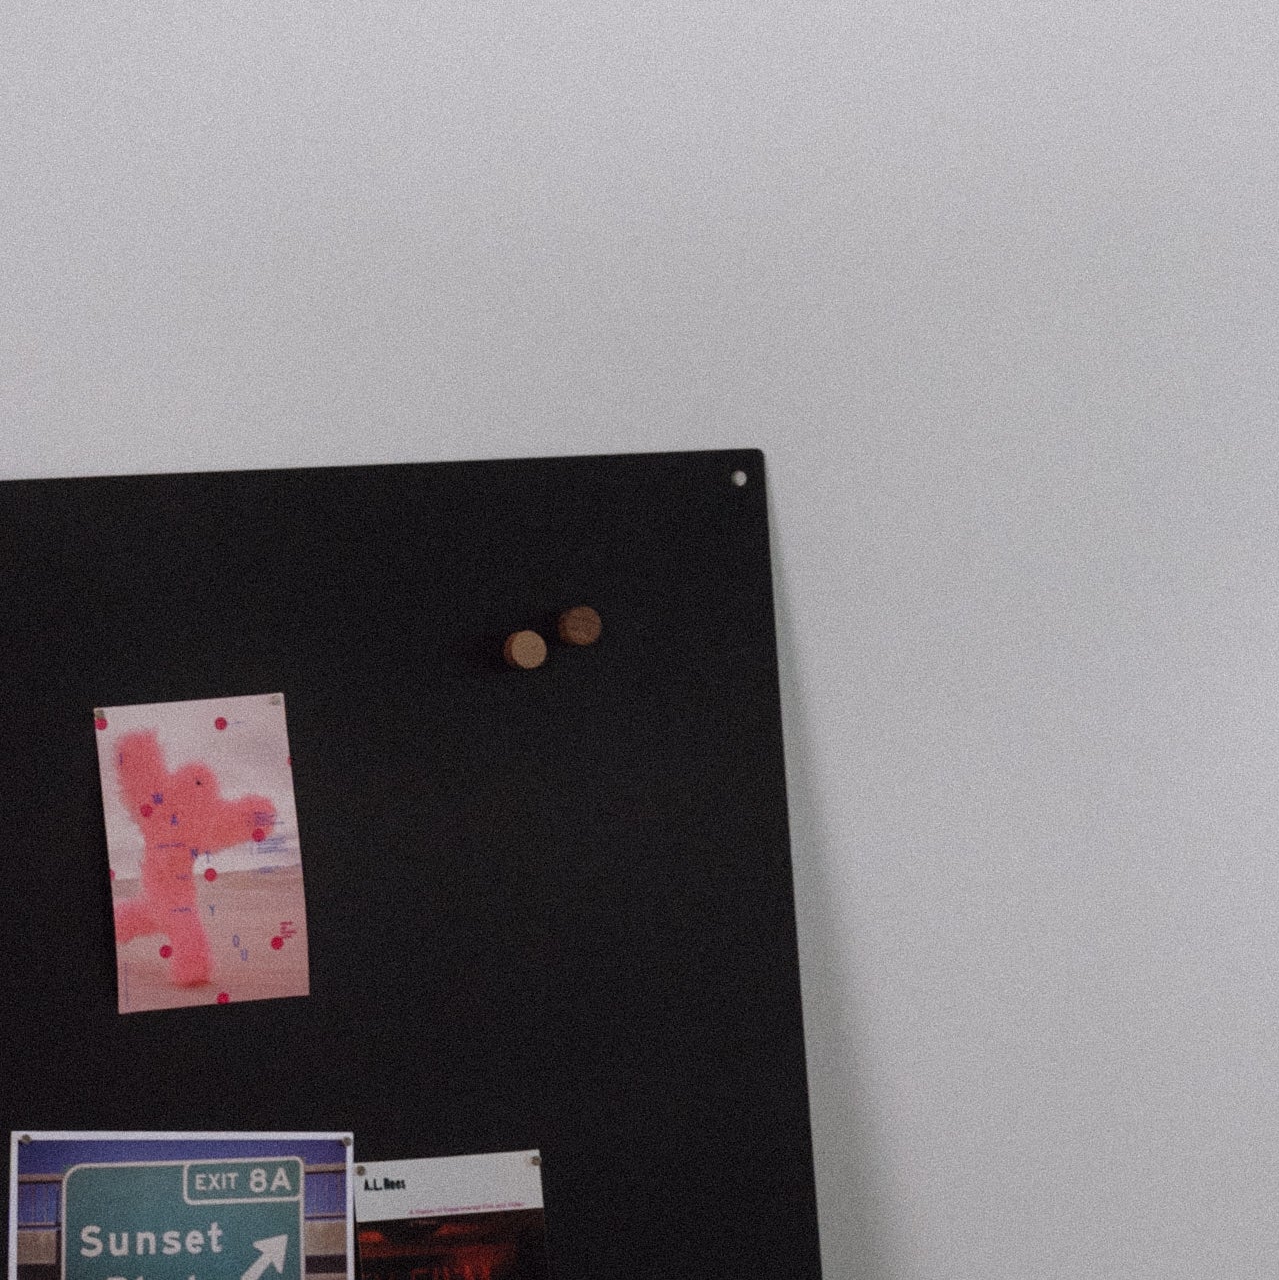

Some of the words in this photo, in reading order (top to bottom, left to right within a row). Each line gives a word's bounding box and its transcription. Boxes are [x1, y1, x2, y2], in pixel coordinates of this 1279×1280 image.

[195, 1172, 239, 1191] EXIT
[249, 1168, 292, 1193] 8A
[80, 1222, 223, 1258] Sunset
